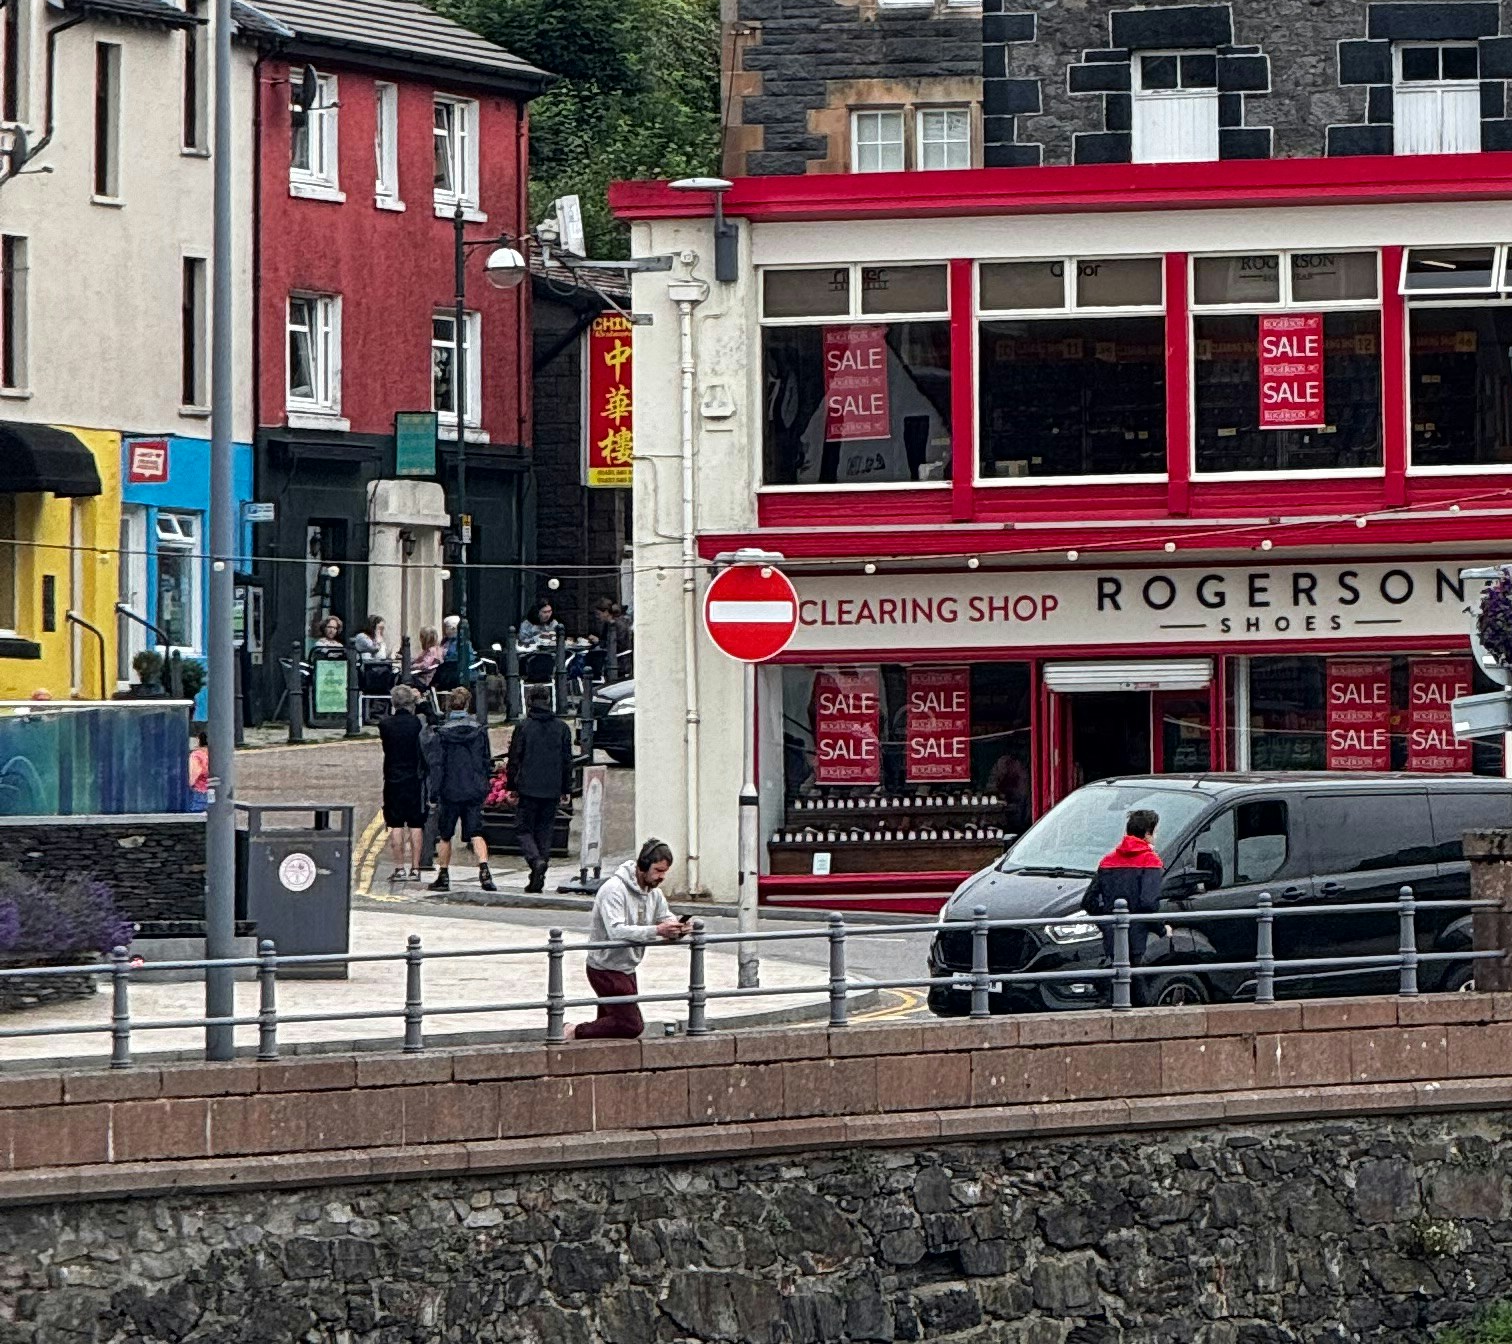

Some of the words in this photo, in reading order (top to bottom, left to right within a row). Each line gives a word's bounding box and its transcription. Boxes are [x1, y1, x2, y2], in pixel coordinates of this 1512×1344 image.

[593, 317, 632, 330] CHIN
[1263, 335, 1319, 358] SALE
[827, 347, 882, 372] SALE
[1263, 381, 1320, 404] SALE
[828, 393, 884, 417] SALE
[1096, 567, 1465, 612] ROGERSON
[798, 596, 959, 626] CLEARING
[967, 594, 1059, 622] SHOP
[1220, 614, 1342, 634] SHOES
[819, 692, 875, 715] SALE
[910, 691, 966, 713] SALE
[1330, 683, 1387, 704] SALE
[819, 738, 875, 760] SALE
[910, 737, 966, 759] SALE
[1330, 729, 1387, 750] SALE
